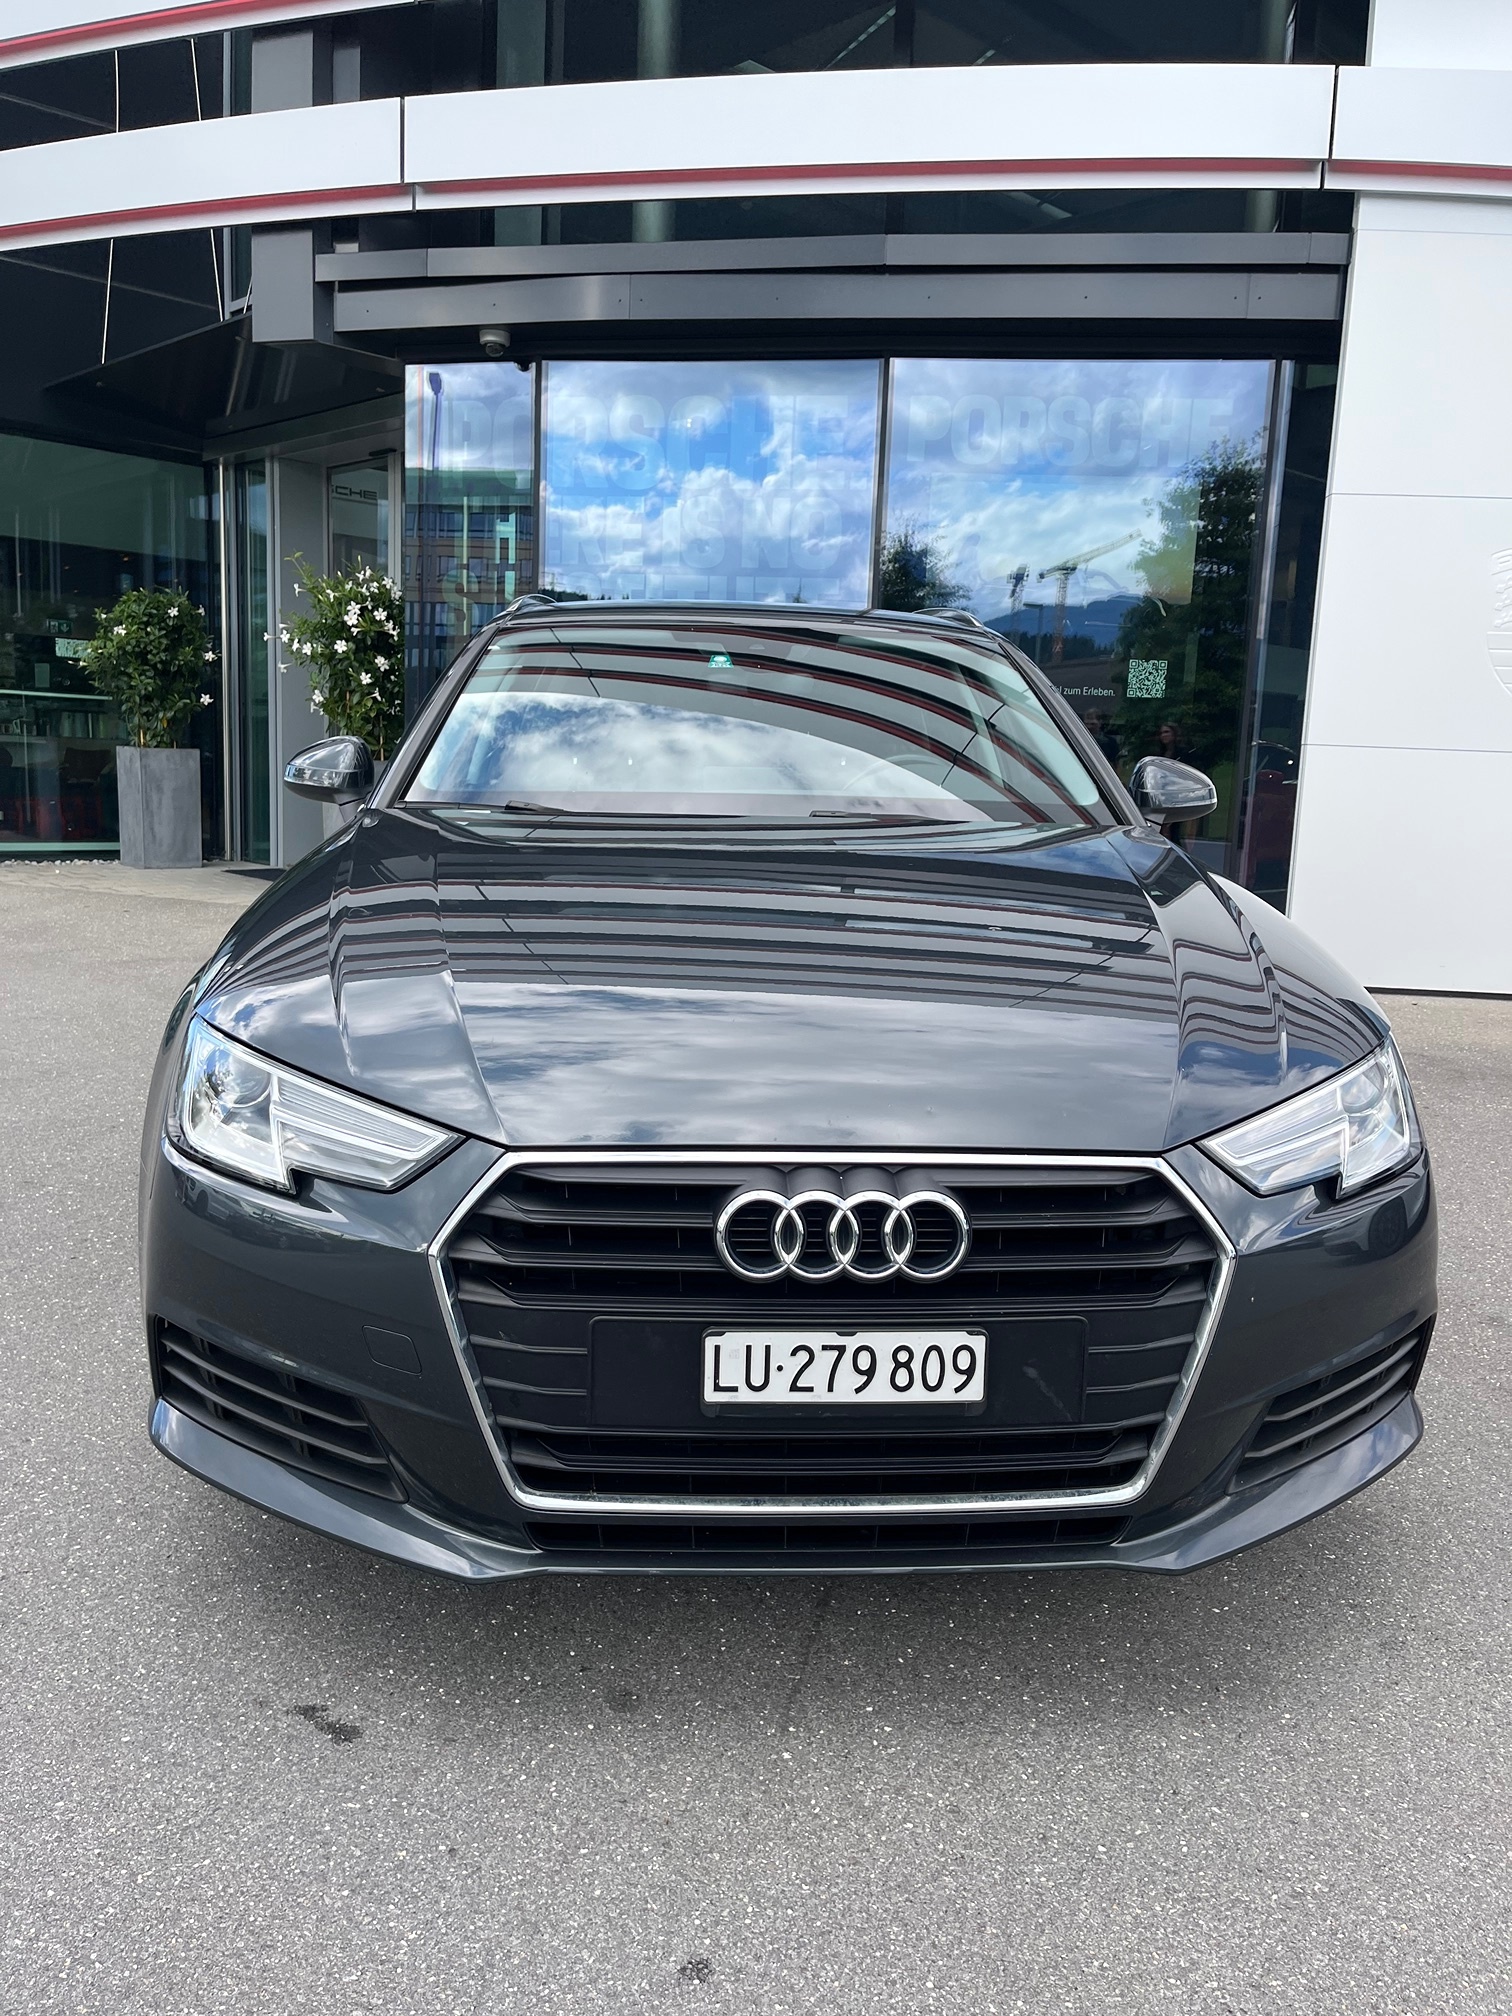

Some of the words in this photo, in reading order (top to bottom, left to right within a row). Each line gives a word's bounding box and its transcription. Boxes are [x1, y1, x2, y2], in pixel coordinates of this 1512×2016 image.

[331, 485, 378, 499] CHE
[741, 495, 842, 570] NO
[1063, 687, 1080, 695] zum
[1083, 687, 1116, 697] Erleben.
[890, 1344, 977, 1394] 809
